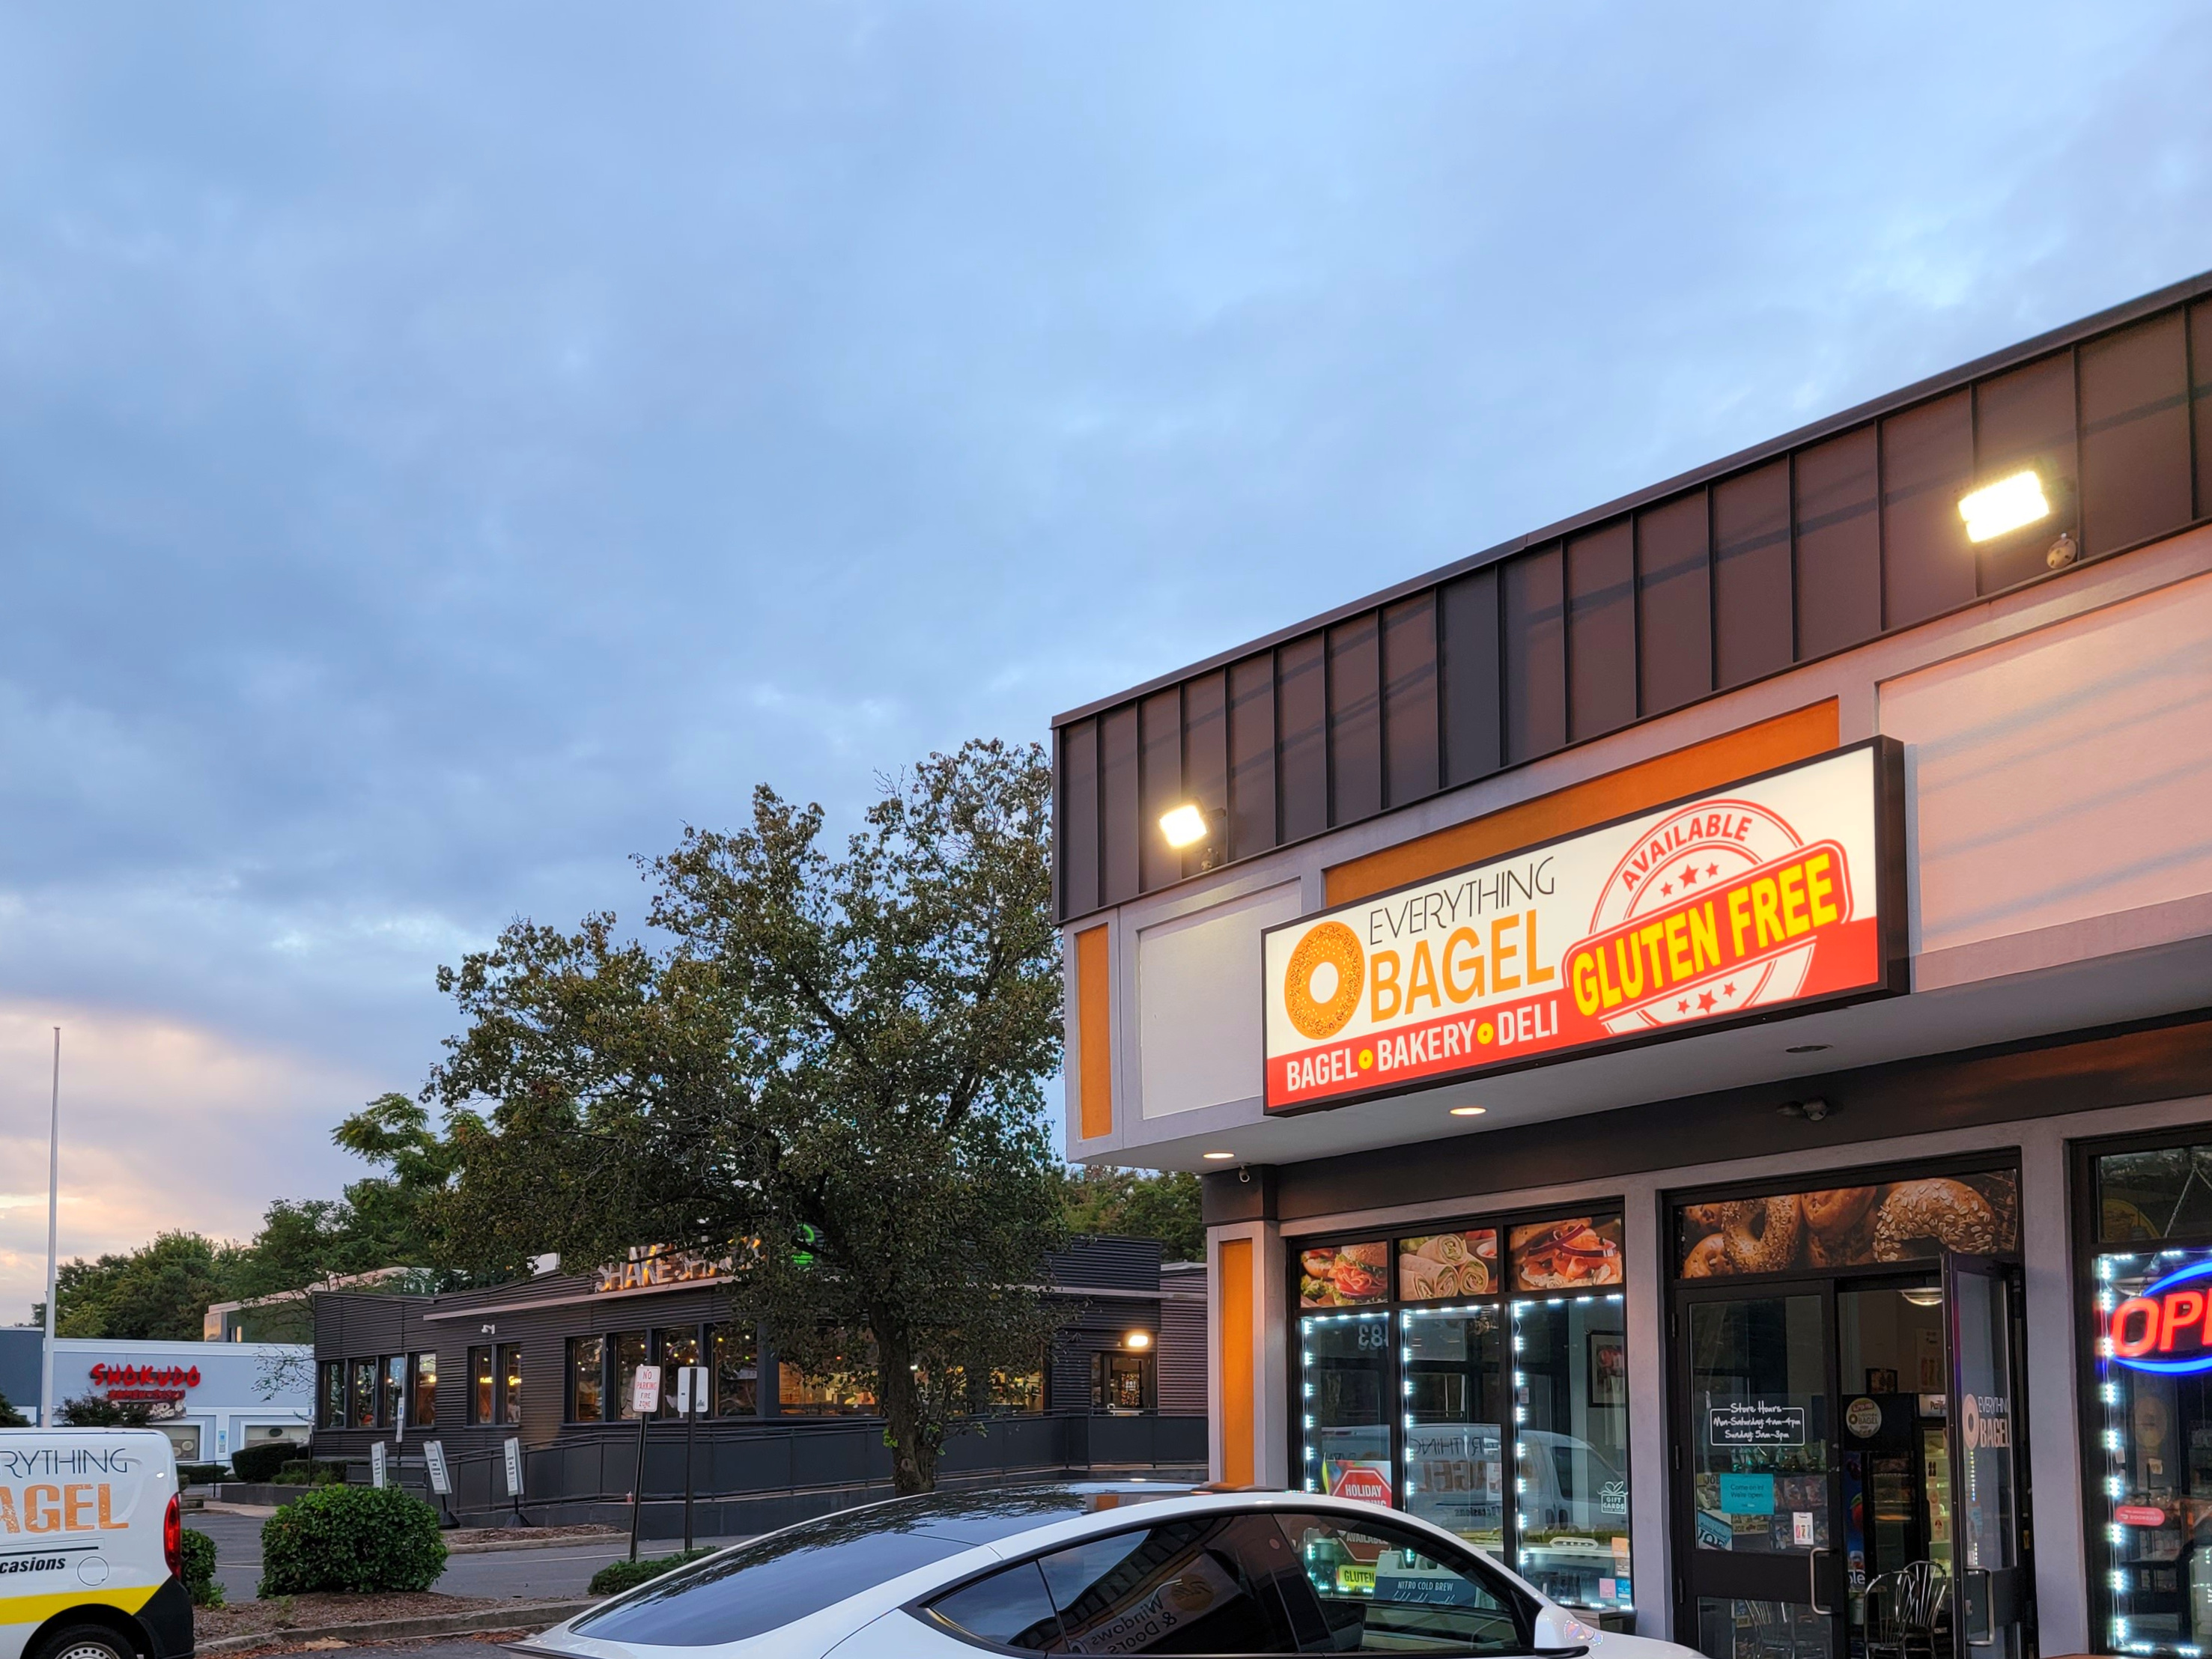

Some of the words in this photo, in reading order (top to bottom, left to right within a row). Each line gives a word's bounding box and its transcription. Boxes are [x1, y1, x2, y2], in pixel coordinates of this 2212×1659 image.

[1621, 813, 1753, 892] AVAILABLE
[1370, 856, 1555, 946] EVERYTHING
[1573, 900, 1722, 1017] GLUTEN
[1727, 852, 1838, 958] FREE
[1370, 908, 1555, 1024] BAGEL
[1286, 1047, 1358, 1092] BAGEL
[1377, 1018, 1477, 1072] BAKERY
[1498, 1000, 1559, 1047] DELI
[91, 1363, 201, 1387] SHOKUDO
[636, 1382, 657, 1390] PARKING
[642, 1371, 653, 1380] NO
[1731, 1402, 1756, 1413] Store
[1757, 1400, 1782, 1415] Hours
[1979, 1418, 2010, 1448] BAGEL
[0, 1448, 127, 1478] RYTHING
[1345, 1485, 1382, 1497] HOLIDAY
[1344, 1570, 1374, 1583] GLUTEN
[1397, 1581, 1417, 1590] NITRO
[1418, 1581, 1434, 1591] COLD
[1435, 1582, 1454, 1592] BREW
